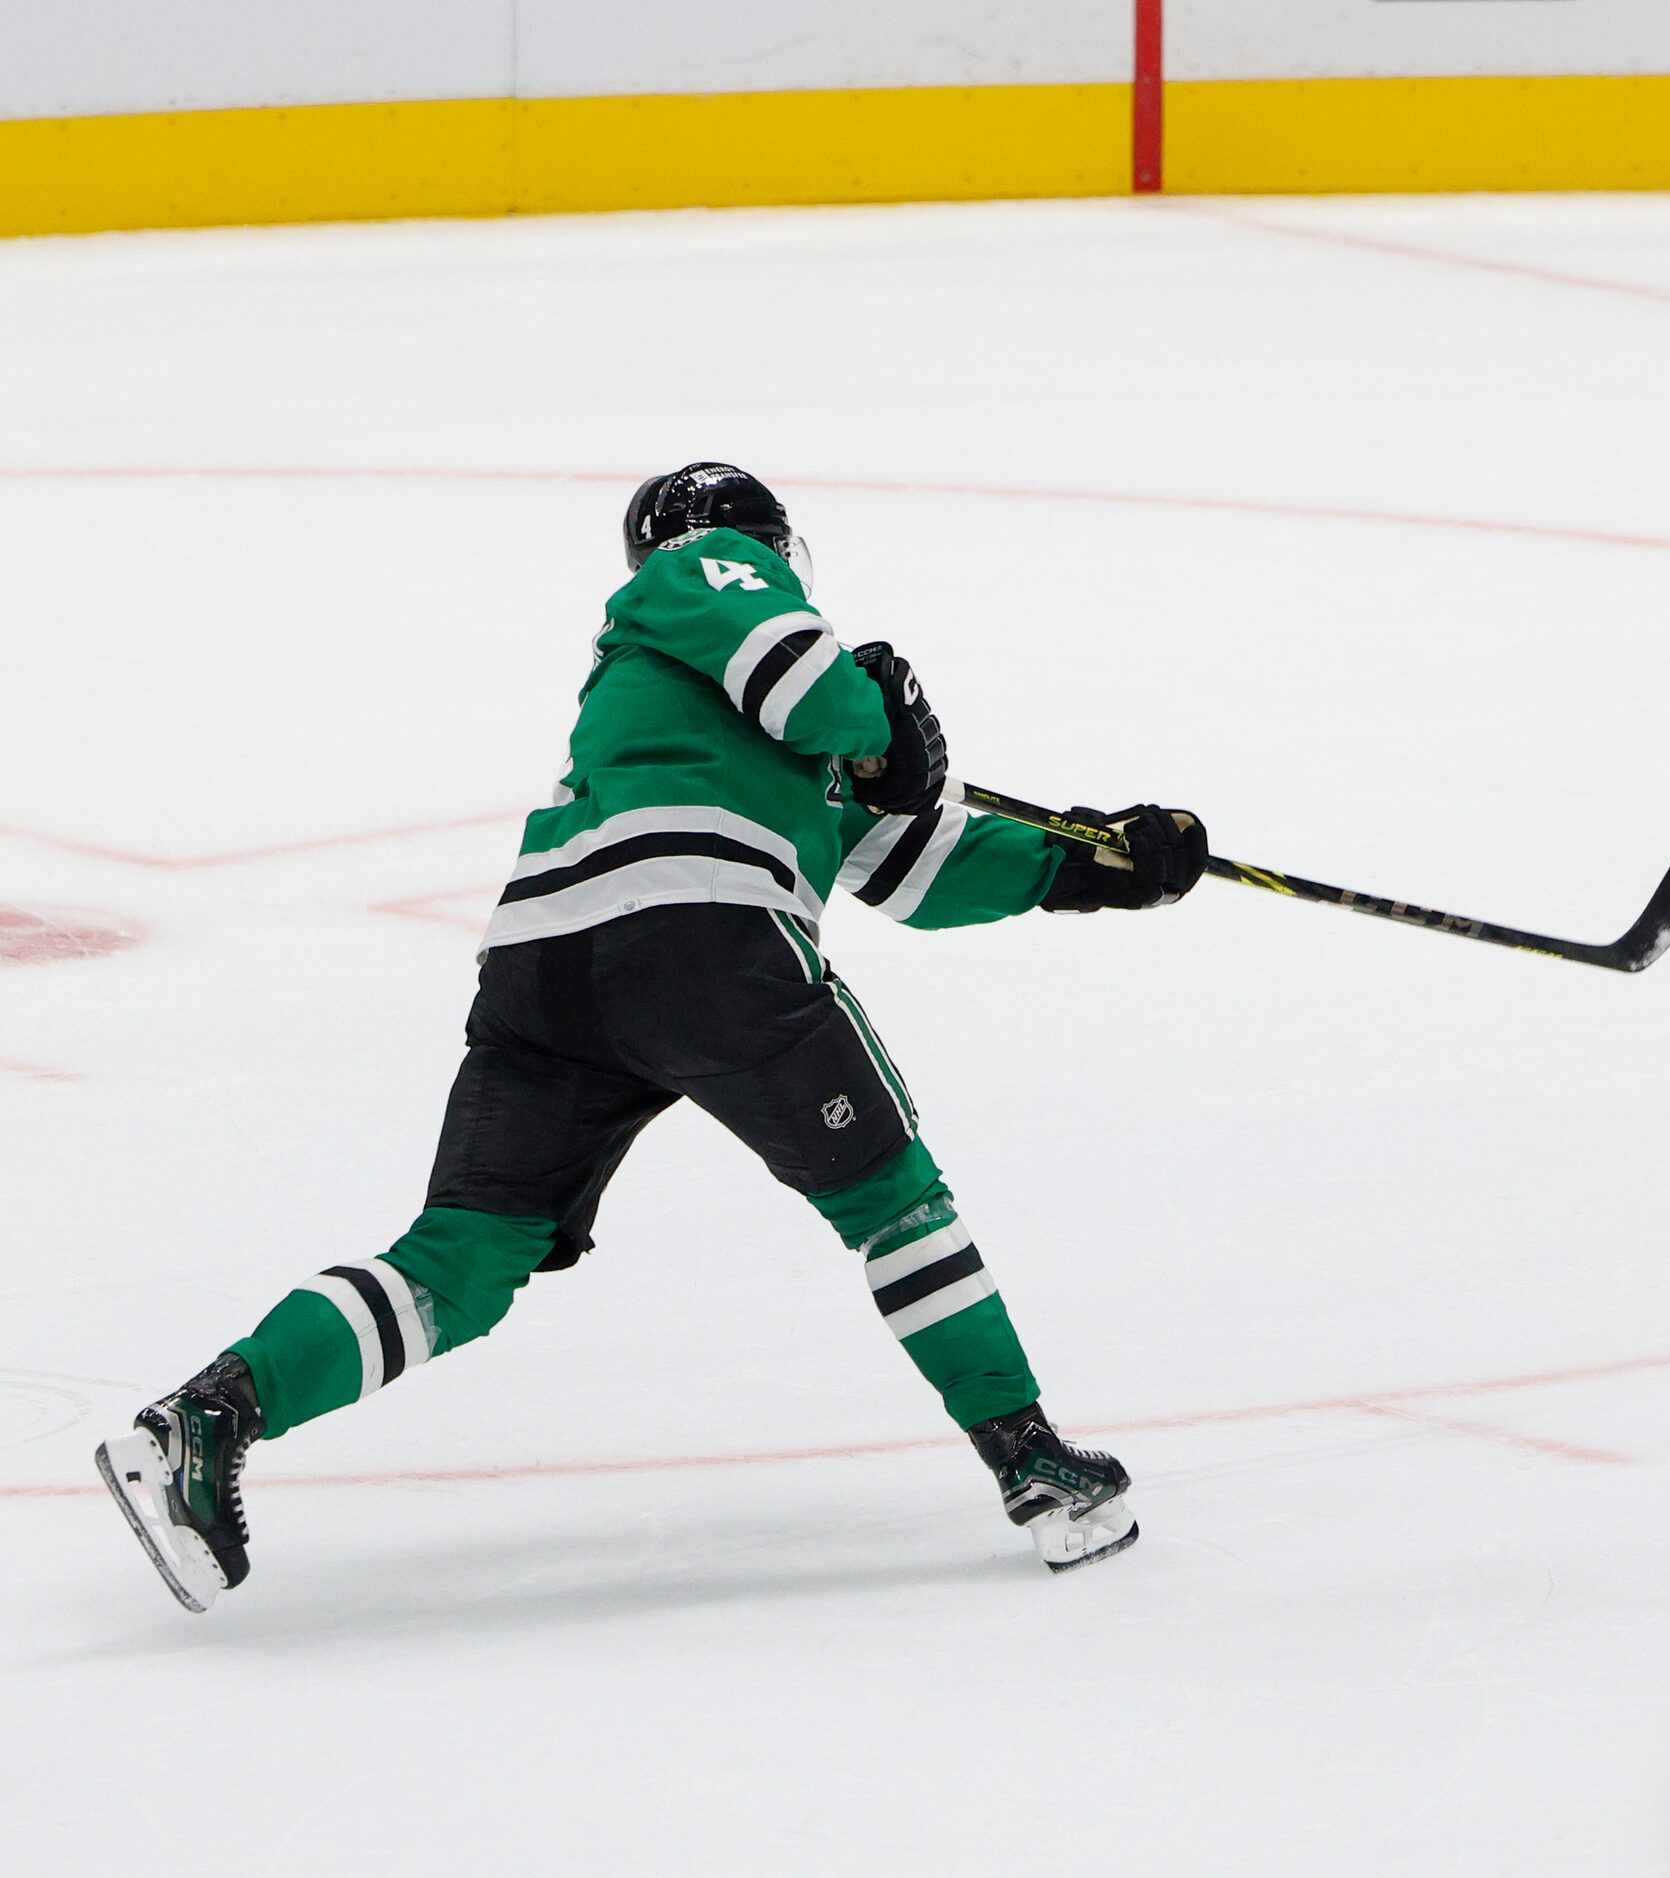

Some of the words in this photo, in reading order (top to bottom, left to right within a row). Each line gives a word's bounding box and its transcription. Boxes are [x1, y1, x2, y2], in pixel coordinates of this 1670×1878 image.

[640, 514, 653, 540] 4
[699, 557, 770, 592] 4
[1048, 814, 1112, 844] SUPER
[190, 1414, 205, 1482] CCM
[1034, 1457, 1105, 1497] CCM
